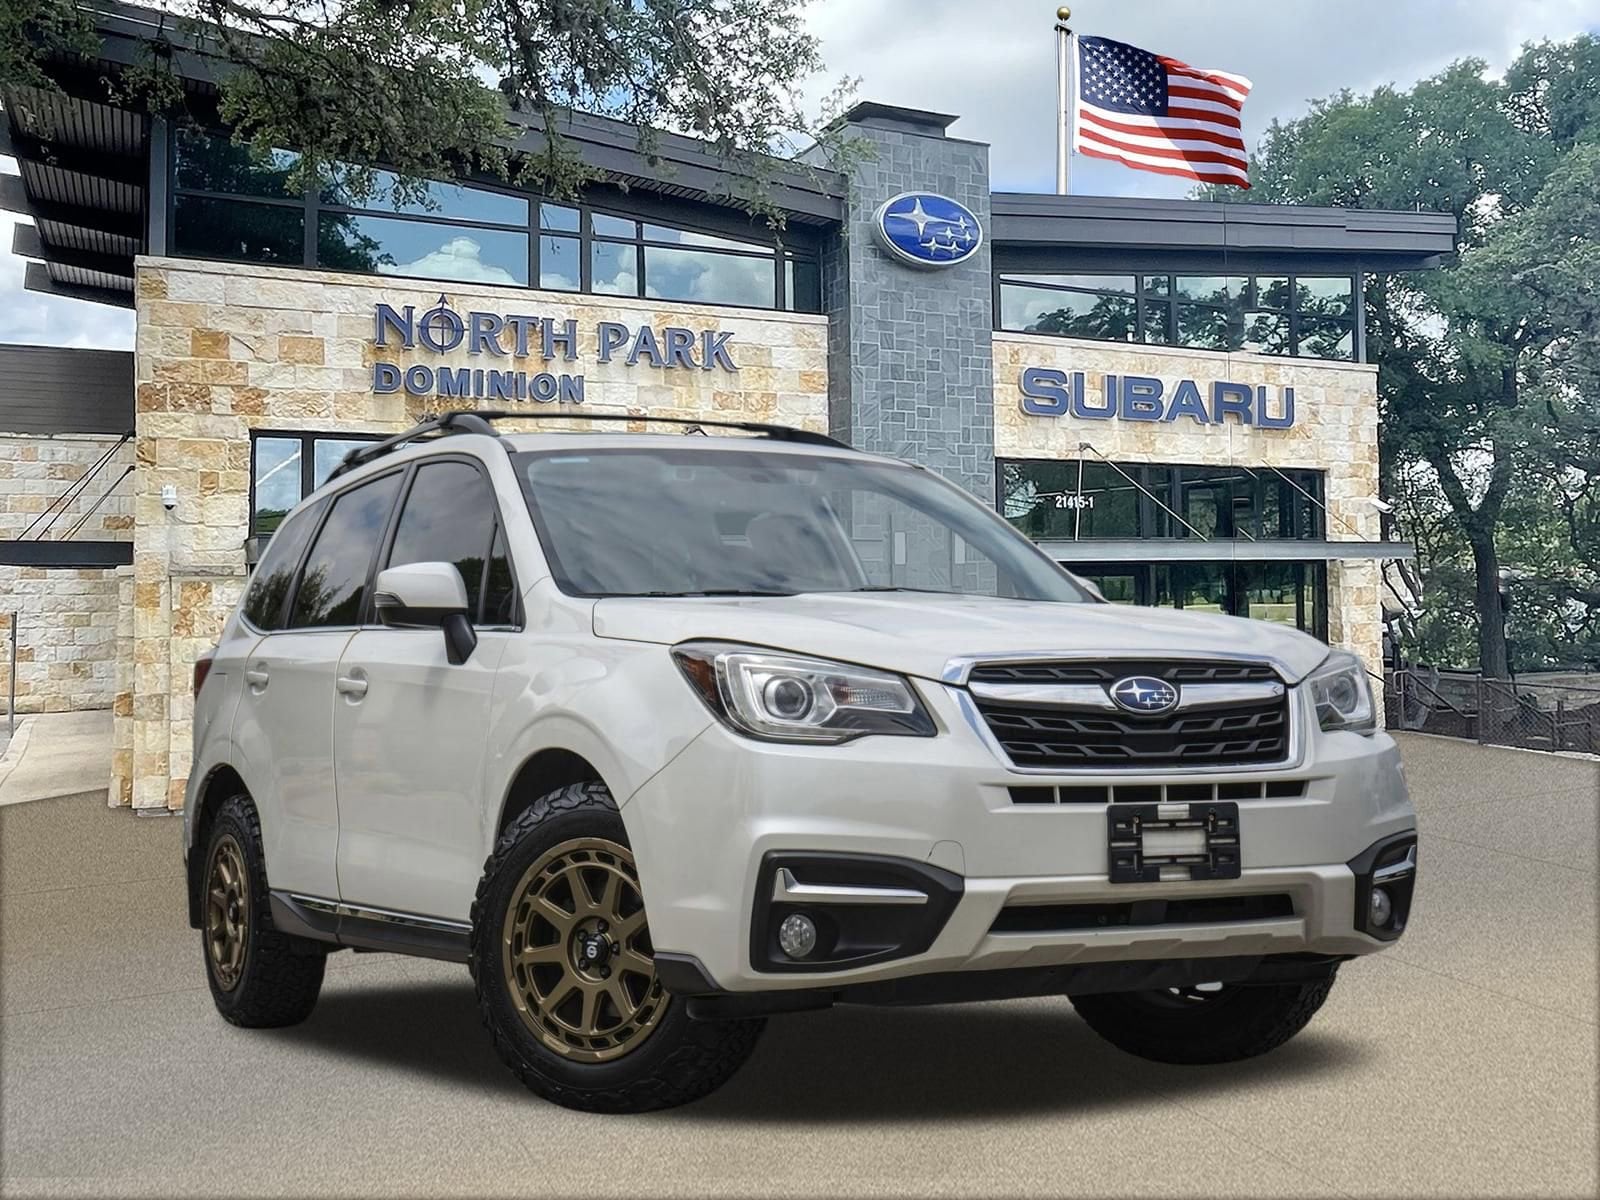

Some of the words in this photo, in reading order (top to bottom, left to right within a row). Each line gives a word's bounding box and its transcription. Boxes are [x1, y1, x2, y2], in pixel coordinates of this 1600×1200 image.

[375, 294, 581, 361] NORTH
[598, 321, 741, 373] PARK
[373, 361, 585, 404] DOMINION
[1019, 367, 1295, 429] SUBARU
